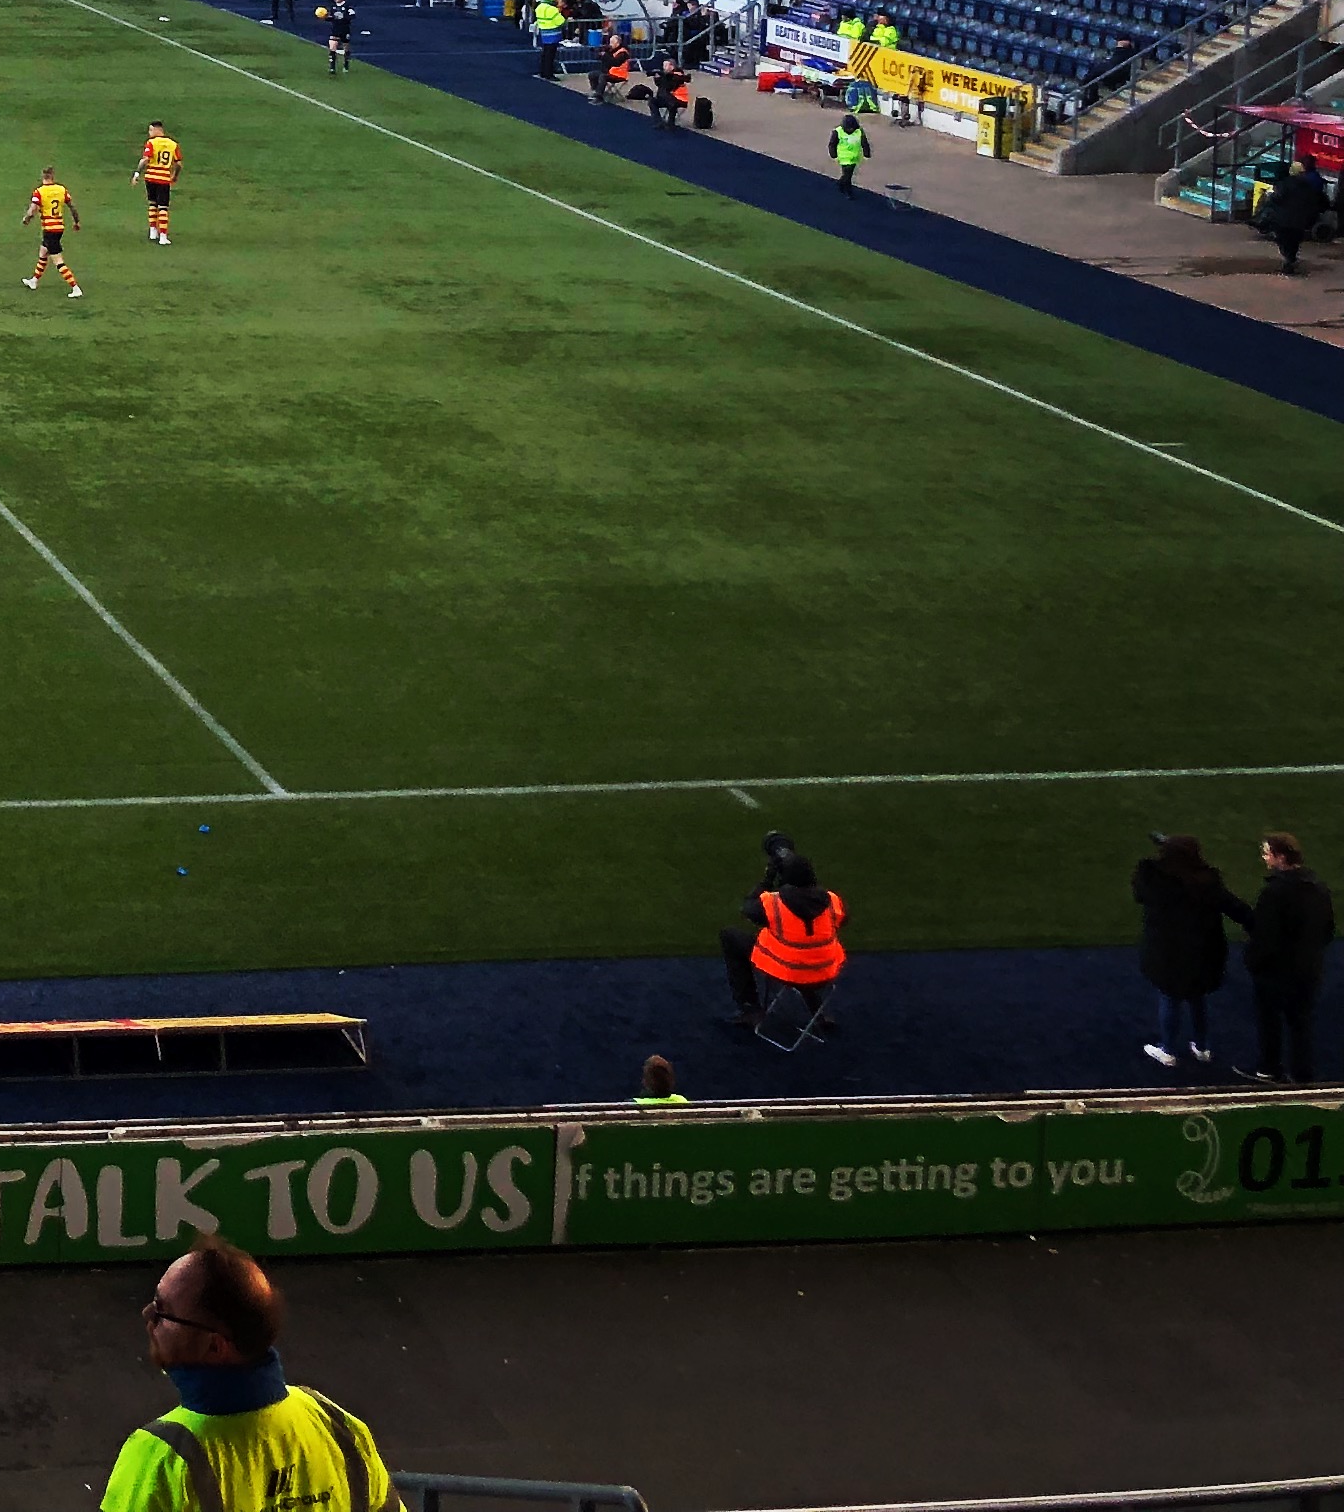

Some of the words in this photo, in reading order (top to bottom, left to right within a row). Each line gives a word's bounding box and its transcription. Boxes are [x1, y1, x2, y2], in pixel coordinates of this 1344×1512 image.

[941, 69, 979, 91] WE'RE
[157, 150, 171, 166] 19
[50, 199, 60, 216] 2
[1238, 1125, 1344, 1192] 01
[241, 1147, 381, 1241] TO
[409, 1144, 534, 1233] US
[603, 1159, 735, 1206] things
[748, 1164, 817, 1196] are
[830, 1155, 979, 1202] getting
[990, 1156, 1035, 1190] to
[1046, 1155, 1136, 1192] you.
